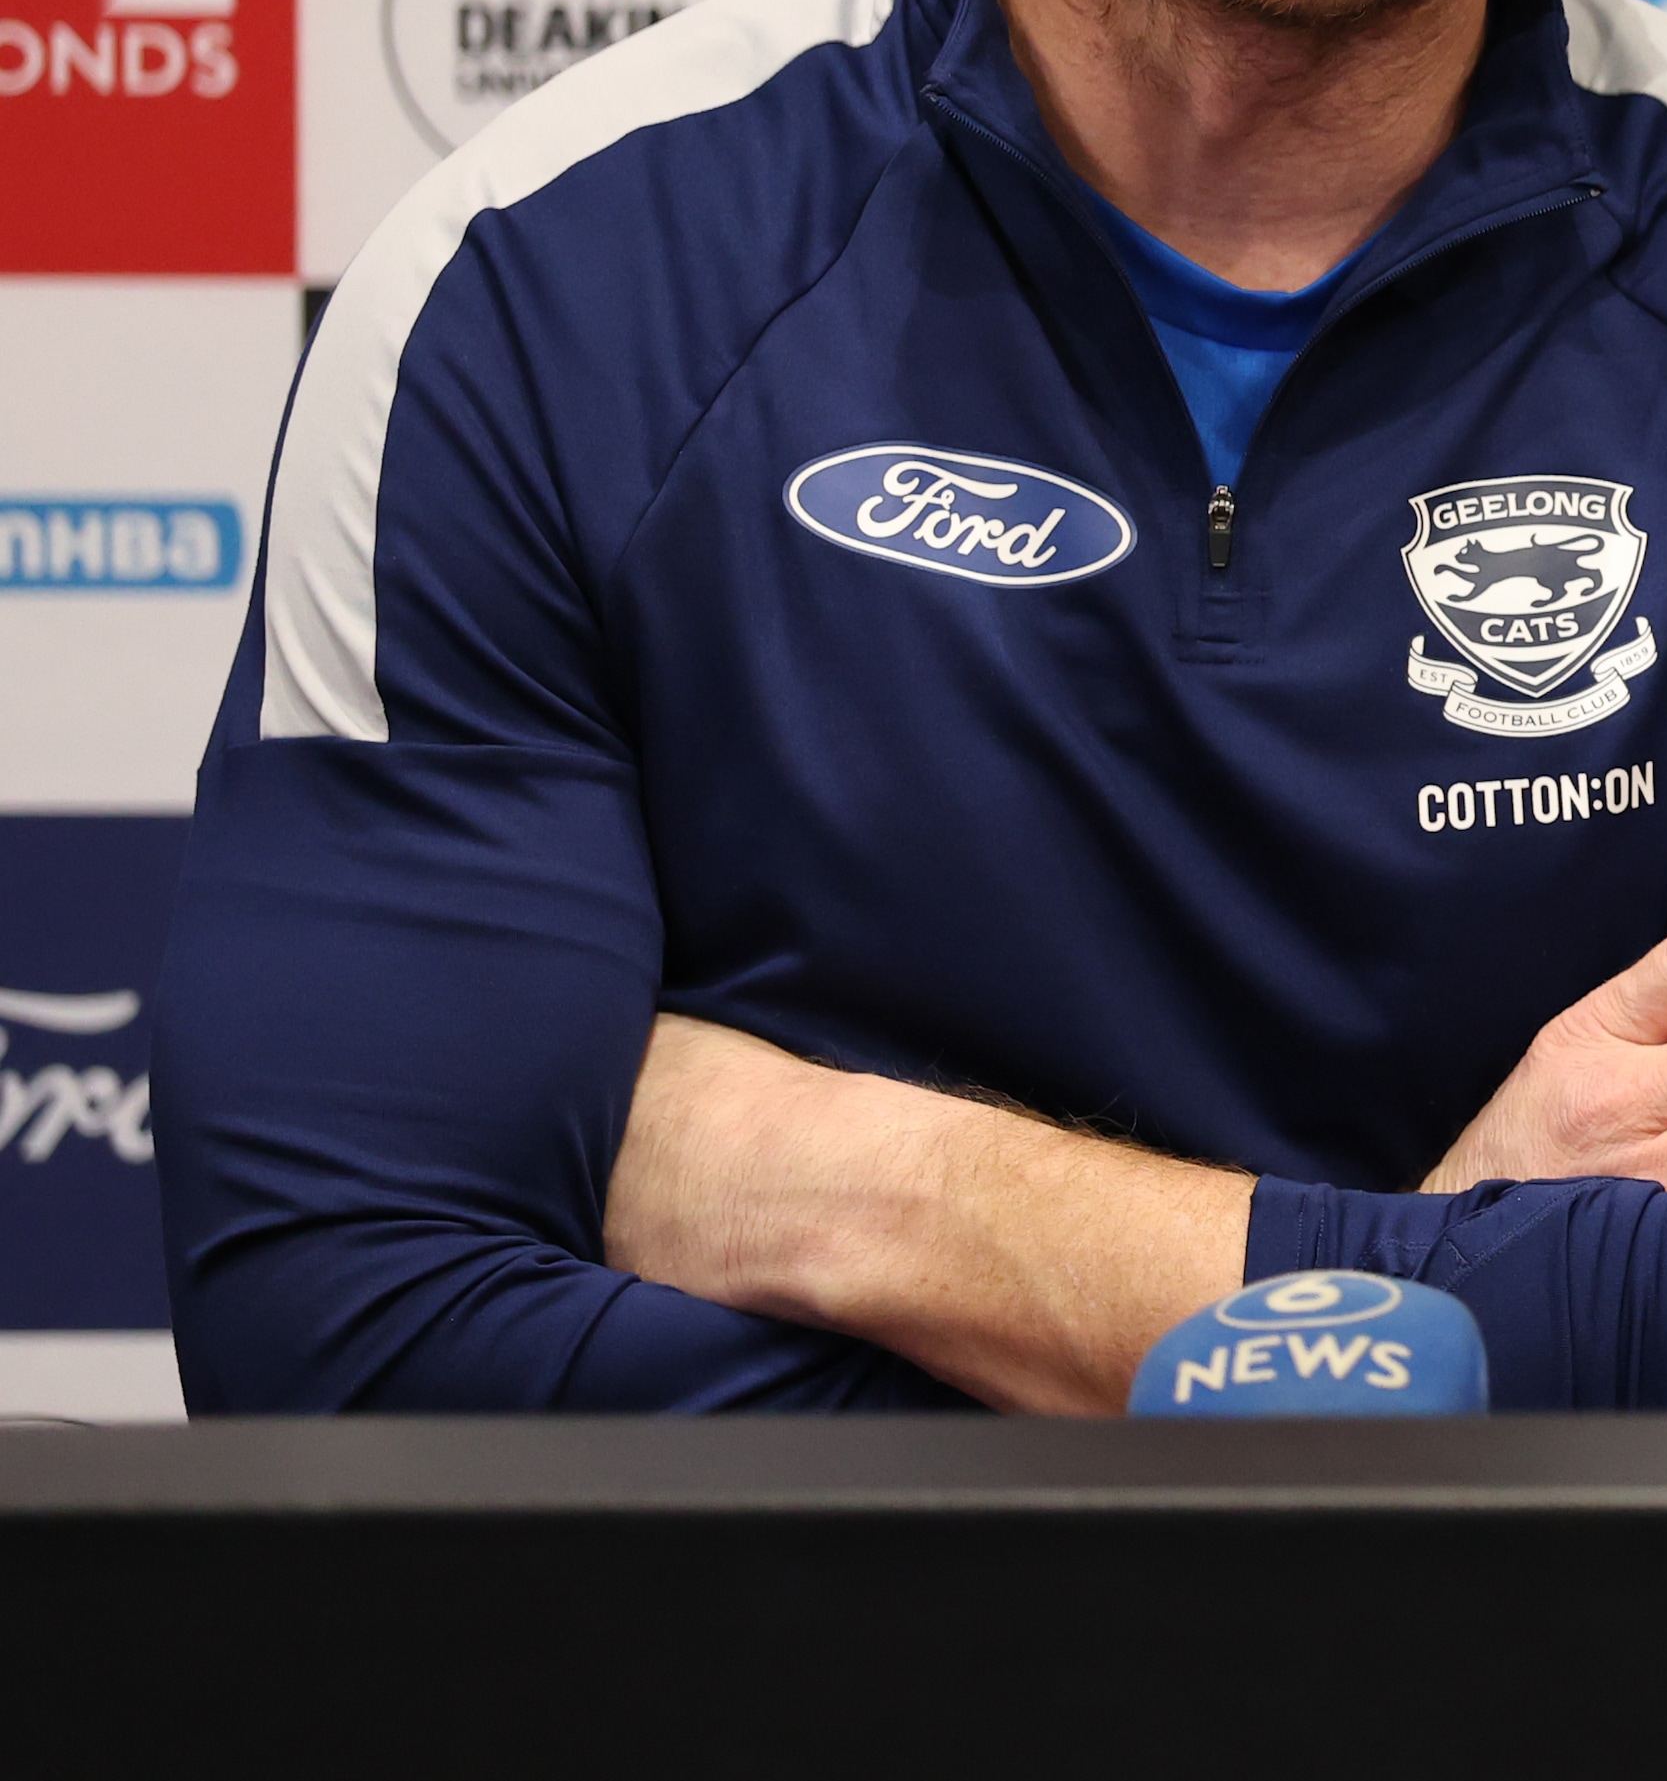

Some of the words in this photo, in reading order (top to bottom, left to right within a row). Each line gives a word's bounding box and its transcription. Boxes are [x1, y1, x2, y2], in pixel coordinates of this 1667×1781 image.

[0, 17, 239, 100] ONDS
[857, 460, 1066, 568] Ford
[1432, 491, 1606, 530] GEELONG
[1480, 612, 1579, 644] CATS
[1420, 669, 1449, 684] EST
[1620, 648, 1650, 669] 1859
[1456, 702, 1563, 727] FOOTBALL
[1567, 689, 1618, 720] CLUB
[1265, 1273, 1342, 1313] 6
[1173, 1332, 1412, 1405] NEWS
